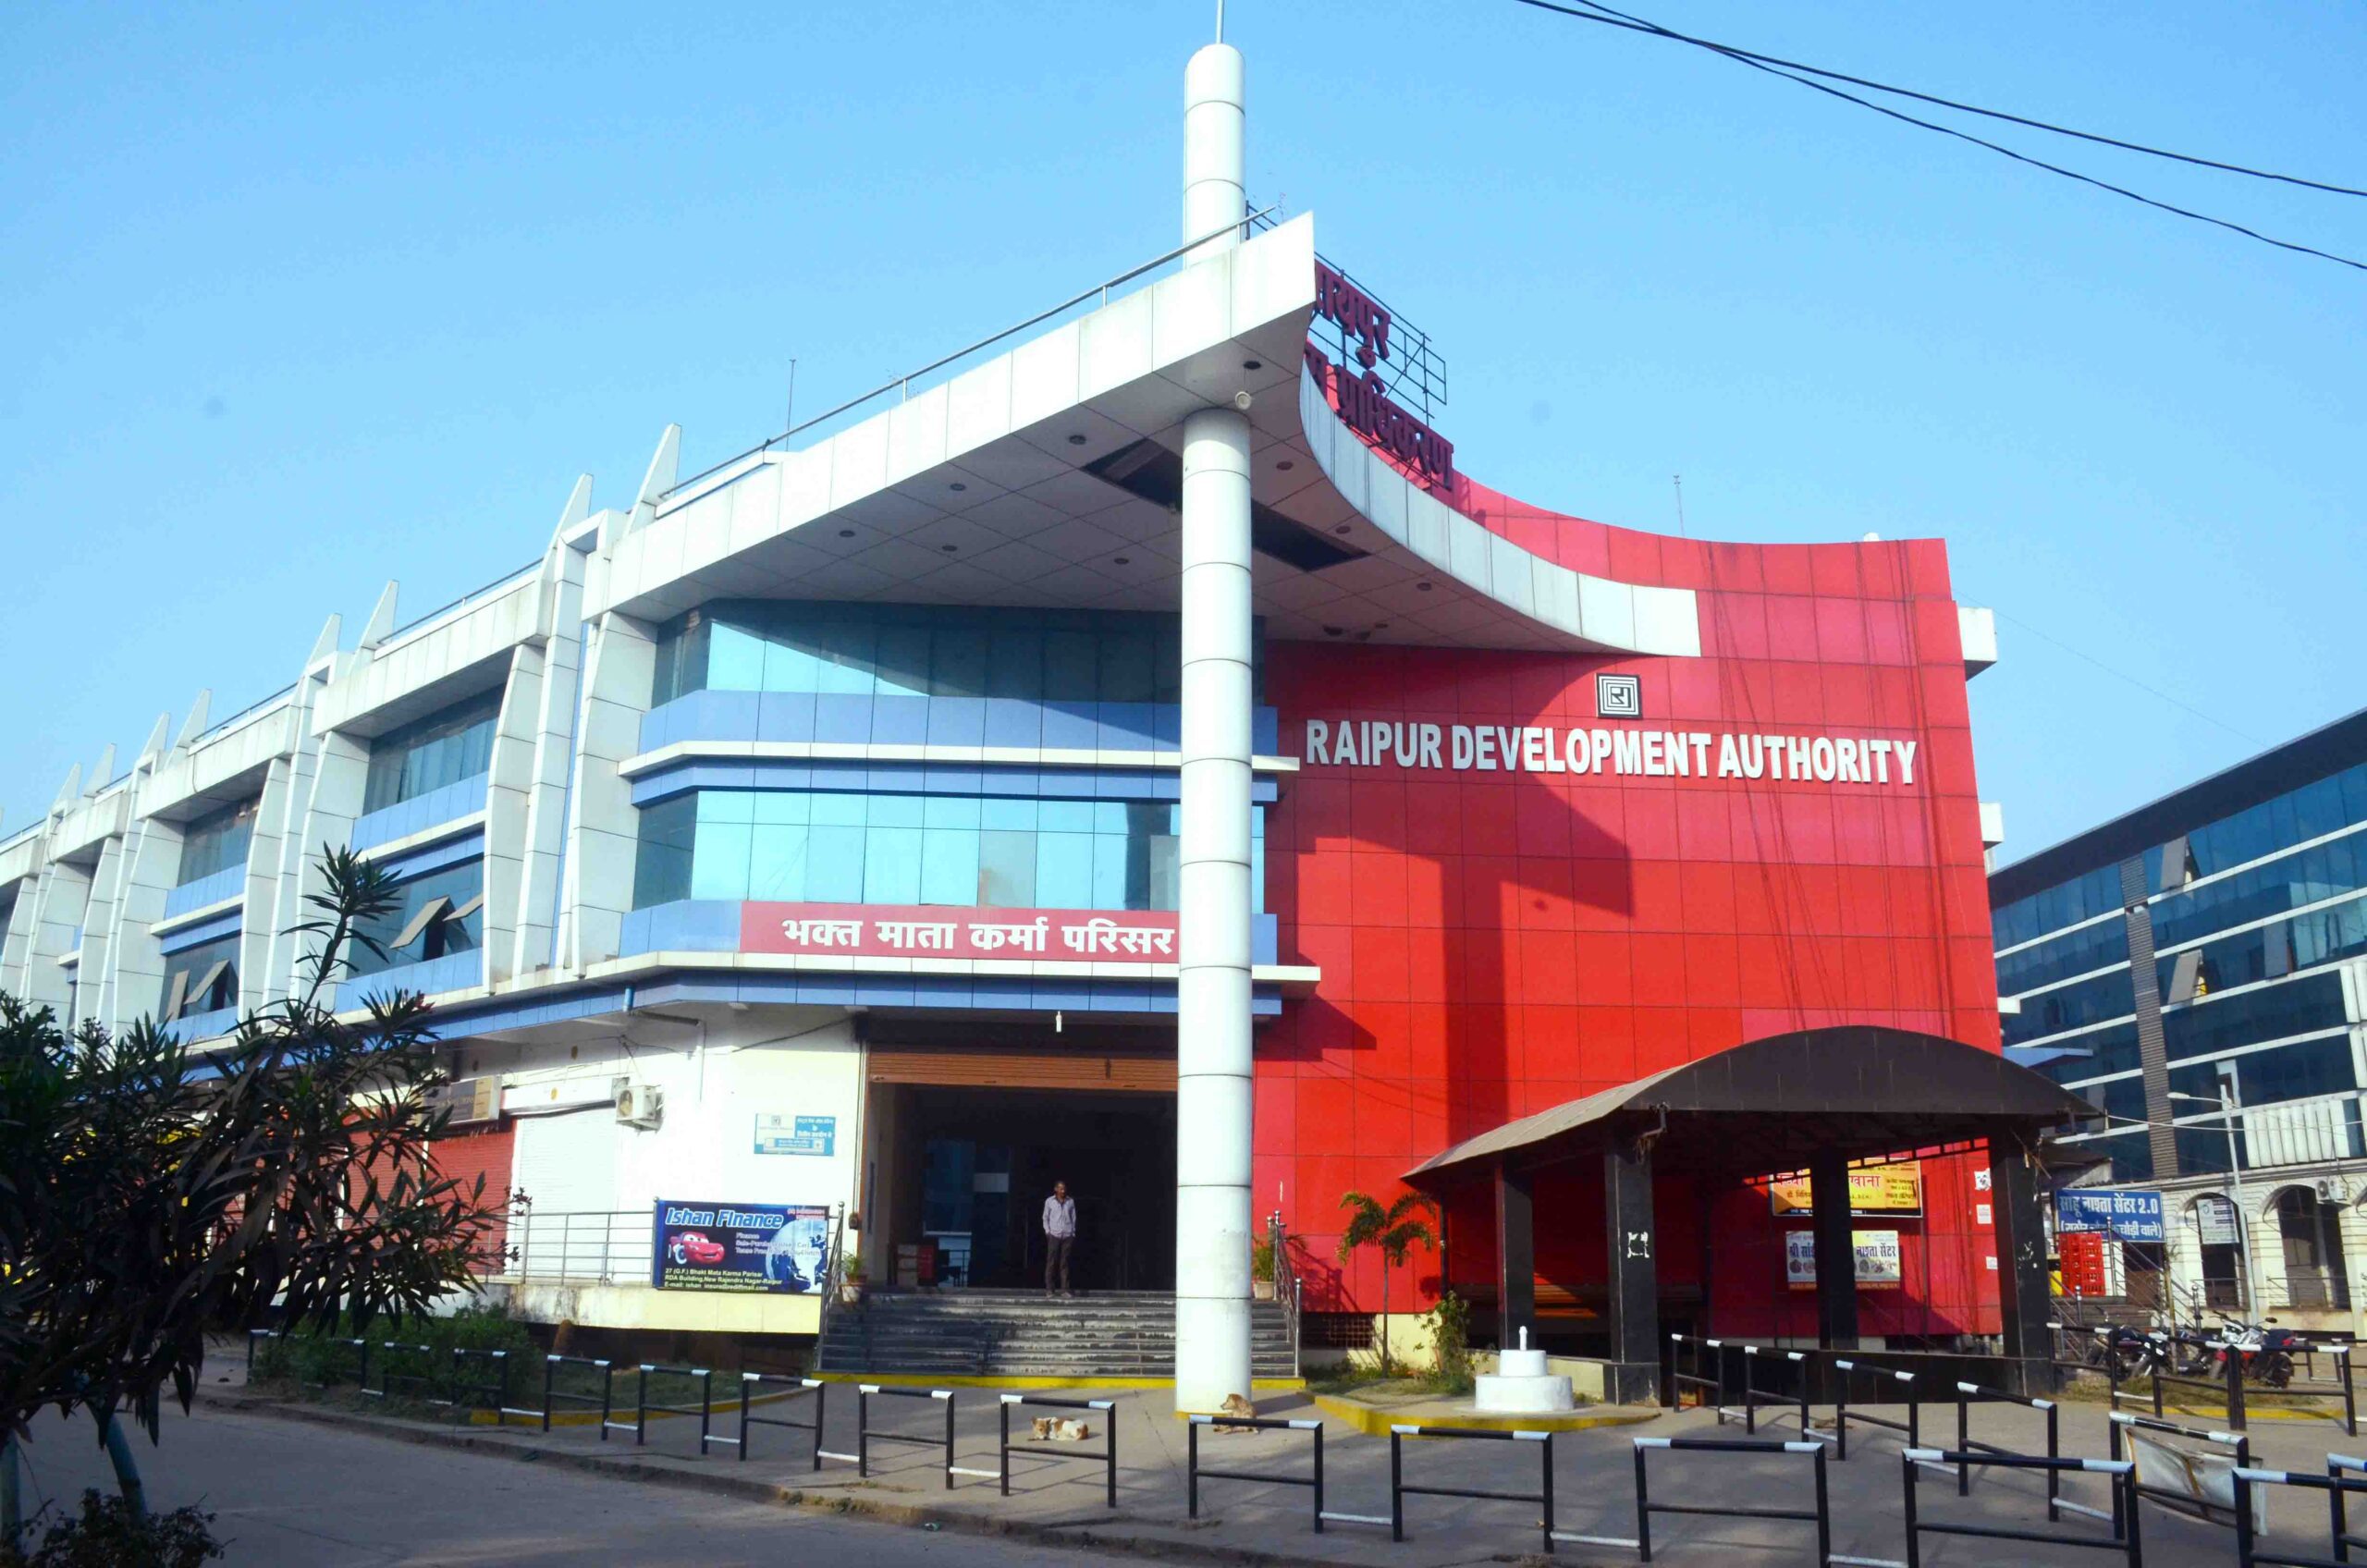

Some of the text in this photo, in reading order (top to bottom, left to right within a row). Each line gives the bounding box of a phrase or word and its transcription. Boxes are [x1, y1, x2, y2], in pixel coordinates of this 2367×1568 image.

[1315, 260, 1390, 369] ायपुर
[1306, 719, 1918, 784] RAIPUR DEVELOPMENT AUTHORITY
[782, 916, 1175, 954] भक्त माता कर्मा परिसर
[665, 1207, 784, 1229] Ishan Finance
[2059, 1193, 2159, 1218] साहू नाश्ता सेंटर 2.0
[1856, 1245, 1878, 1258] नाश्ता
[1881, 1243, 1896, 1258] सेंटर
